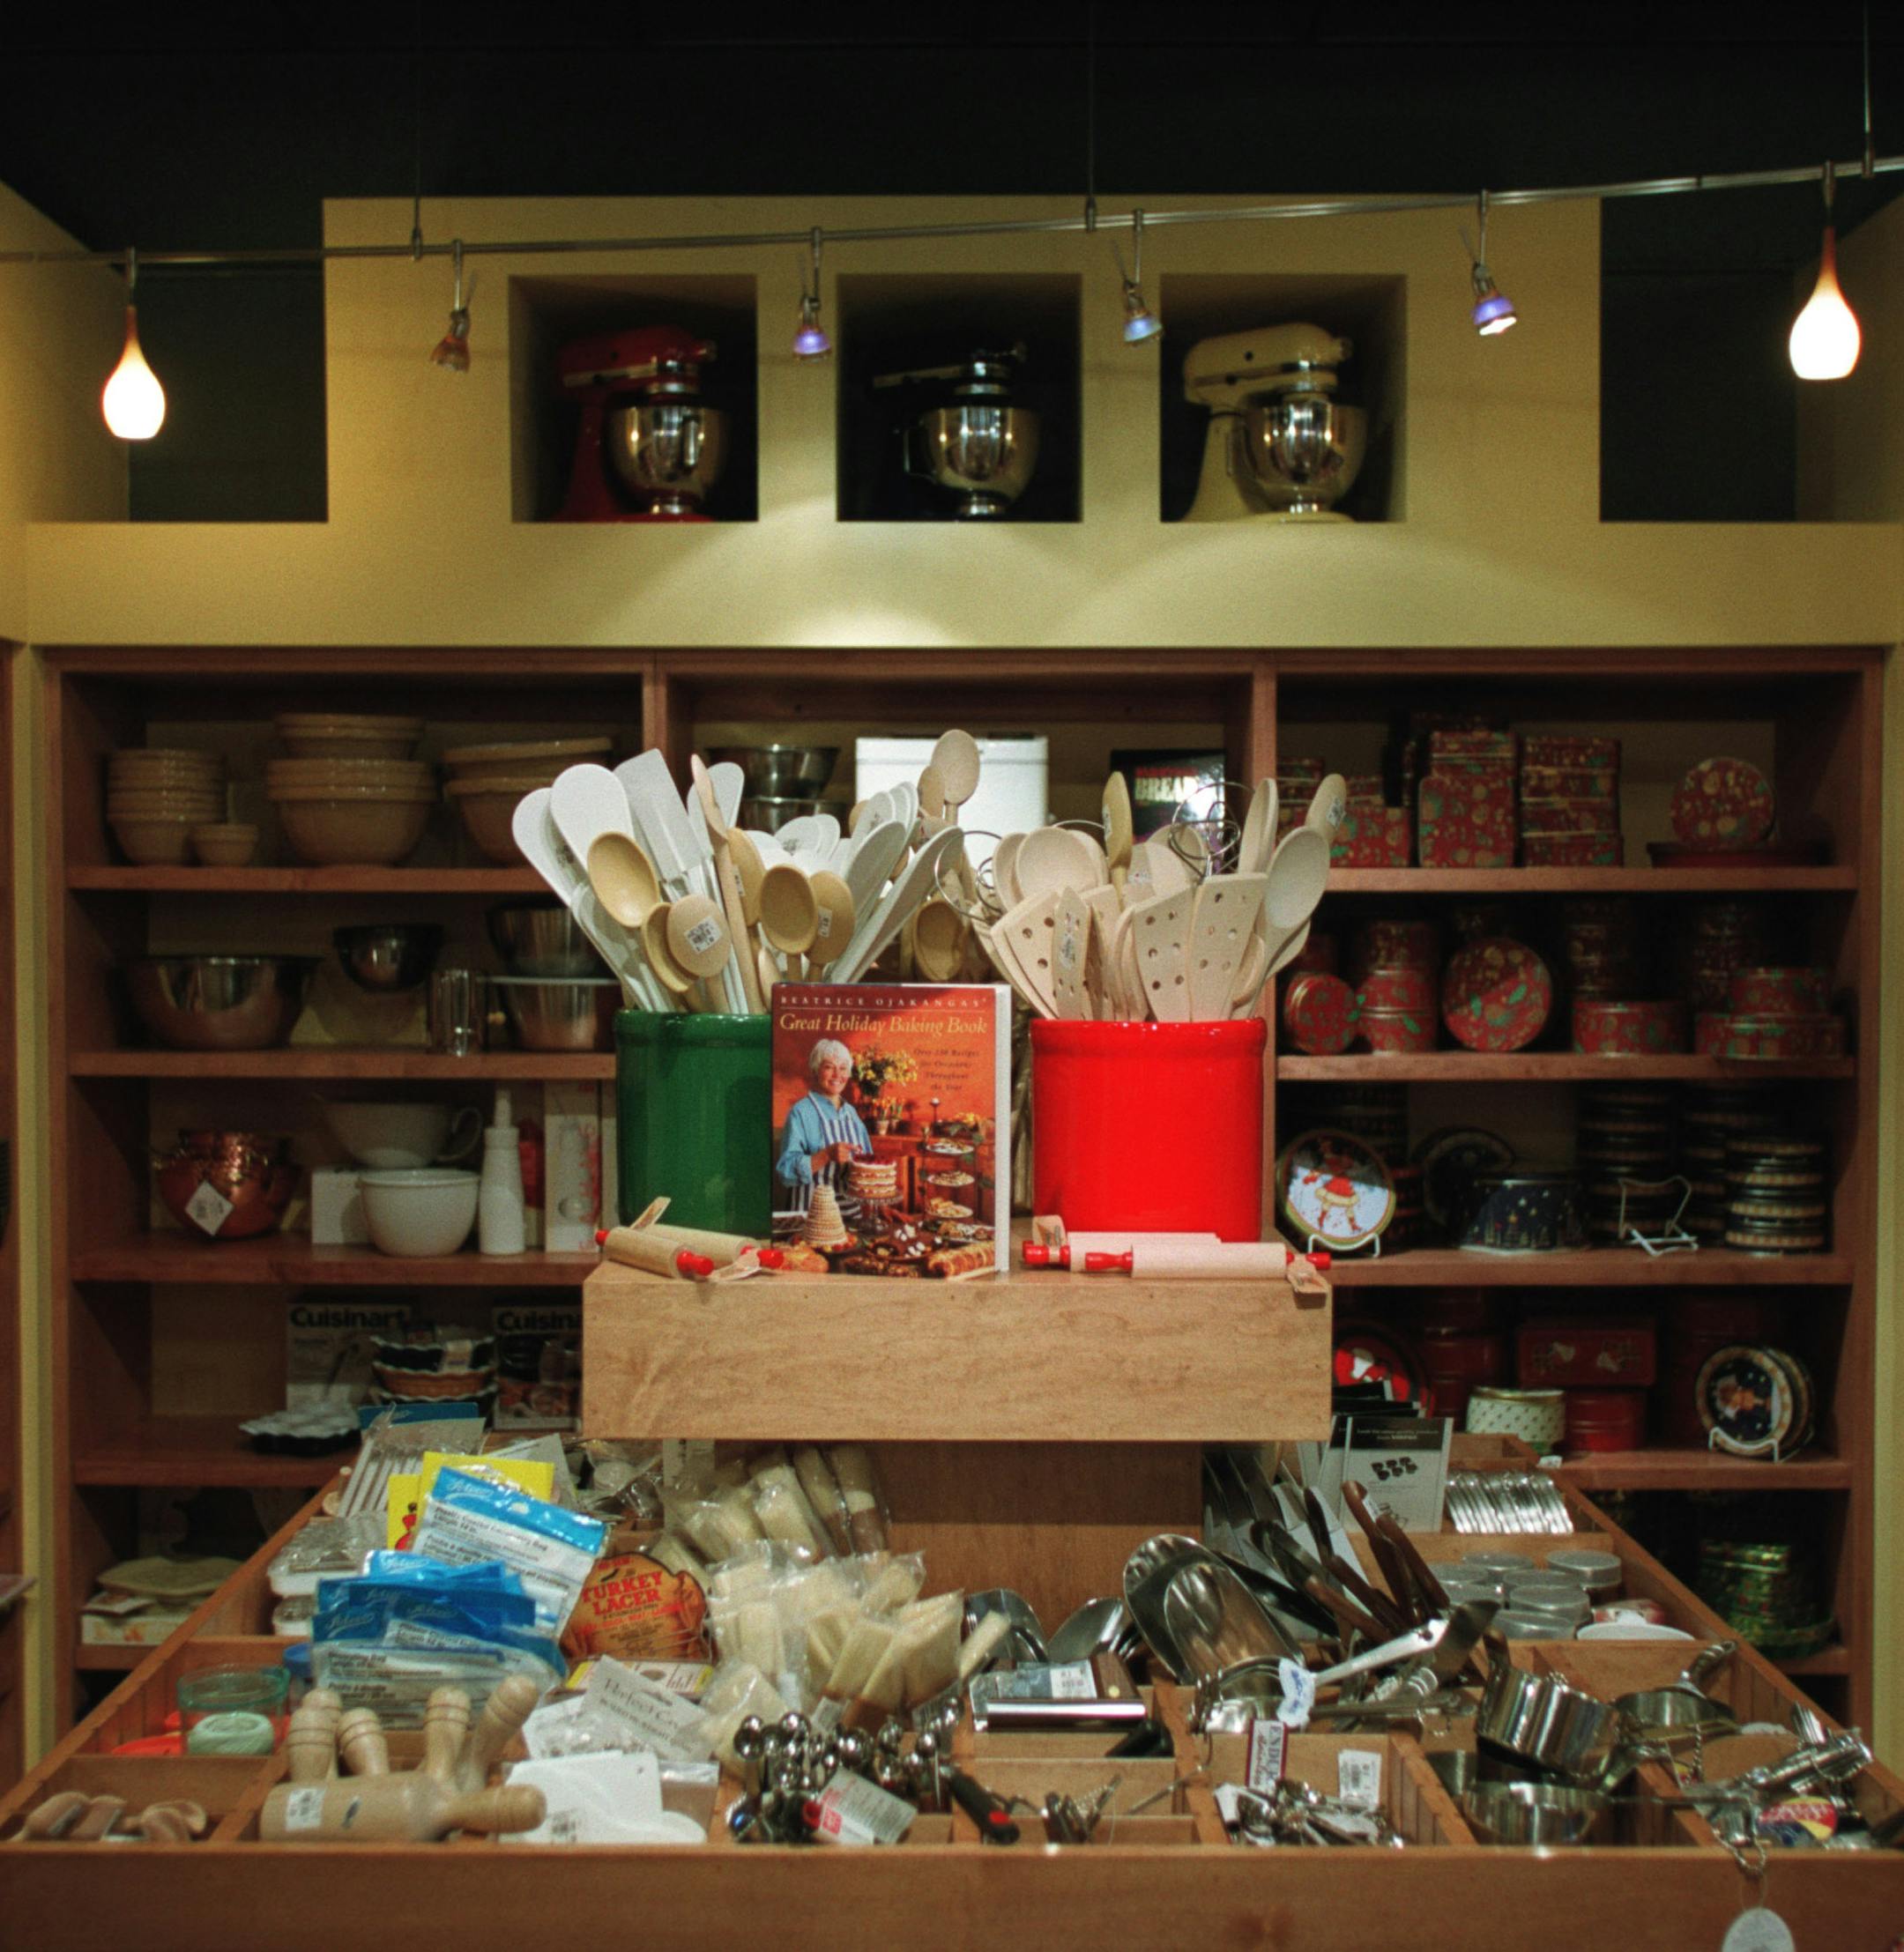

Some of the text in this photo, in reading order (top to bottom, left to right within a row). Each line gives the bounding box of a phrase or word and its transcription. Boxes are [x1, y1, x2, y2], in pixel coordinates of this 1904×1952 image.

[781, 996, 864, 1006] BEATRICE
[779, 1013, 987, 1037] Great Holiday Baking Book
[289, 1306, 405, 1327] Cuisinart
[582, 1571, 663, 1603] TURKEY
[592, 1588, 662, 1617] LACER
